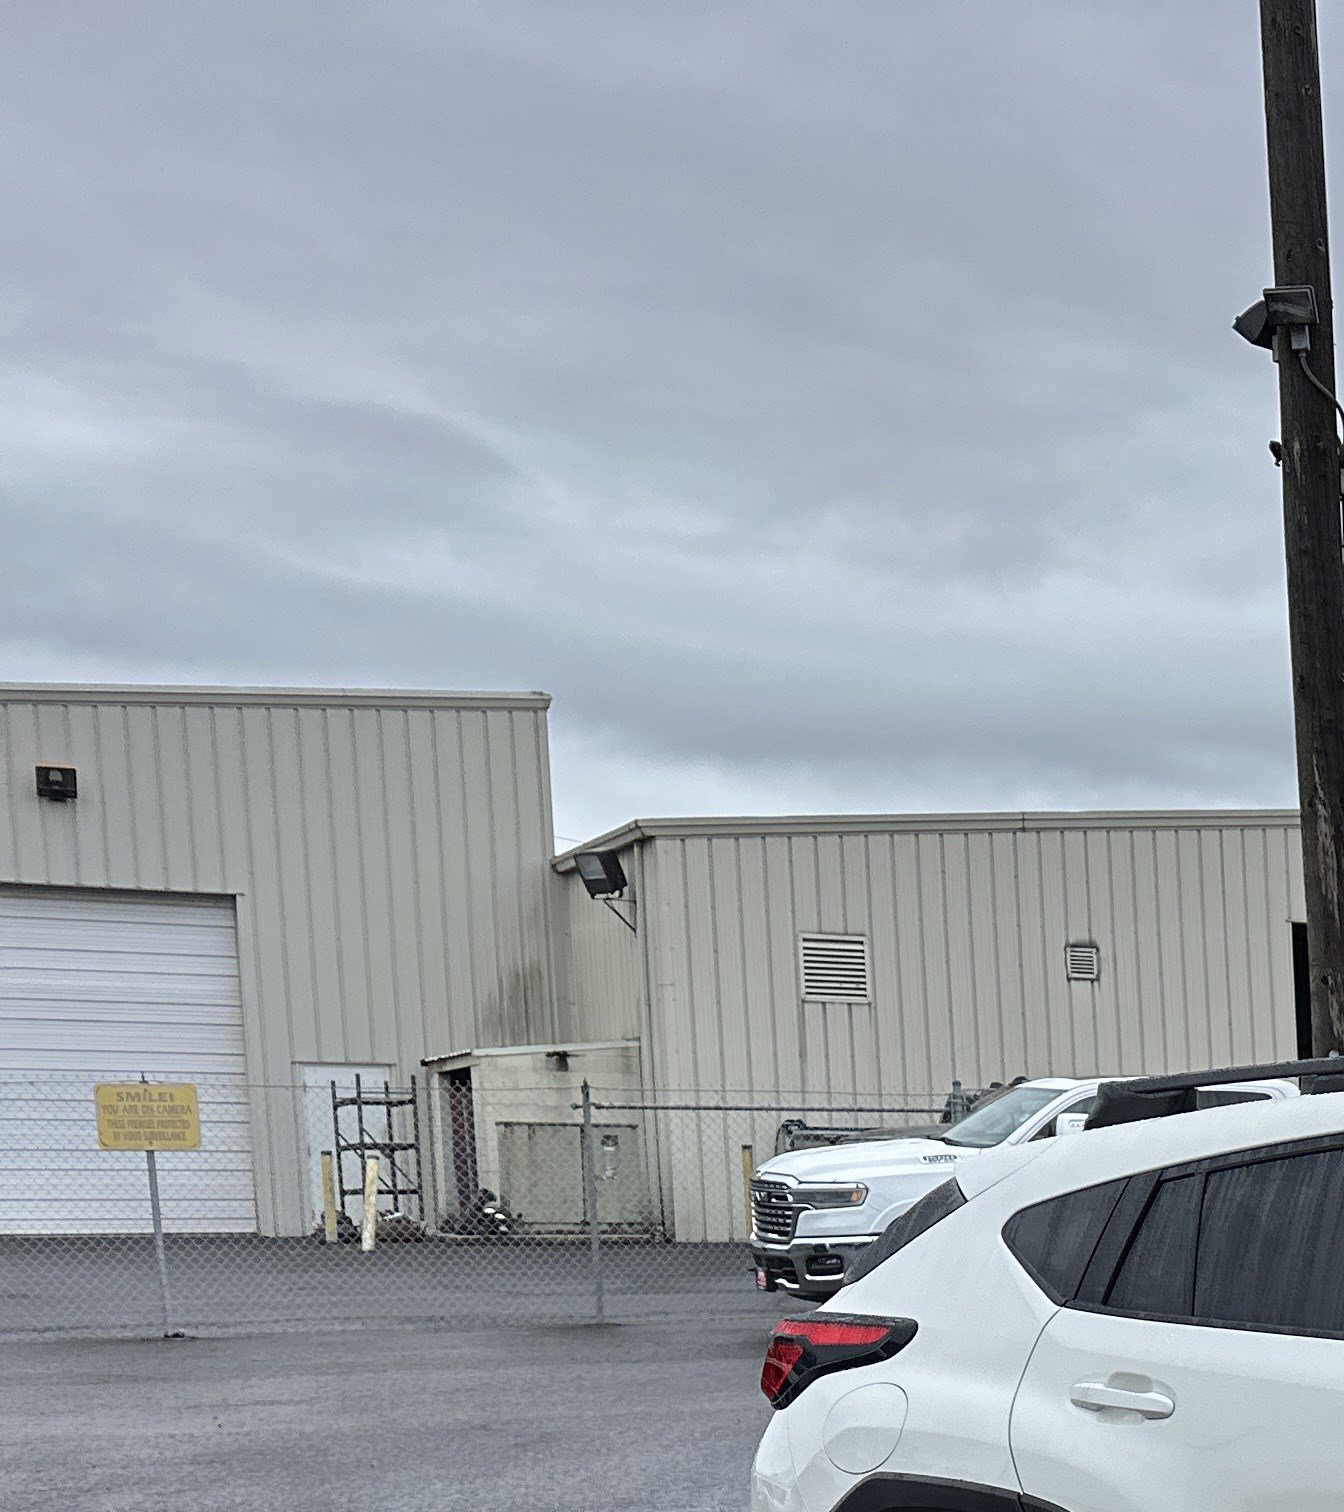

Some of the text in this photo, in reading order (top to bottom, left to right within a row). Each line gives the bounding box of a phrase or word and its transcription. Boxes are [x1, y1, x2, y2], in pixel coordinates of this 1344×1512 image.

[115, 1091, 175, 1103] SMILE!
[101, 1104, 192, 1115] YOU ARE ON CAMERA
